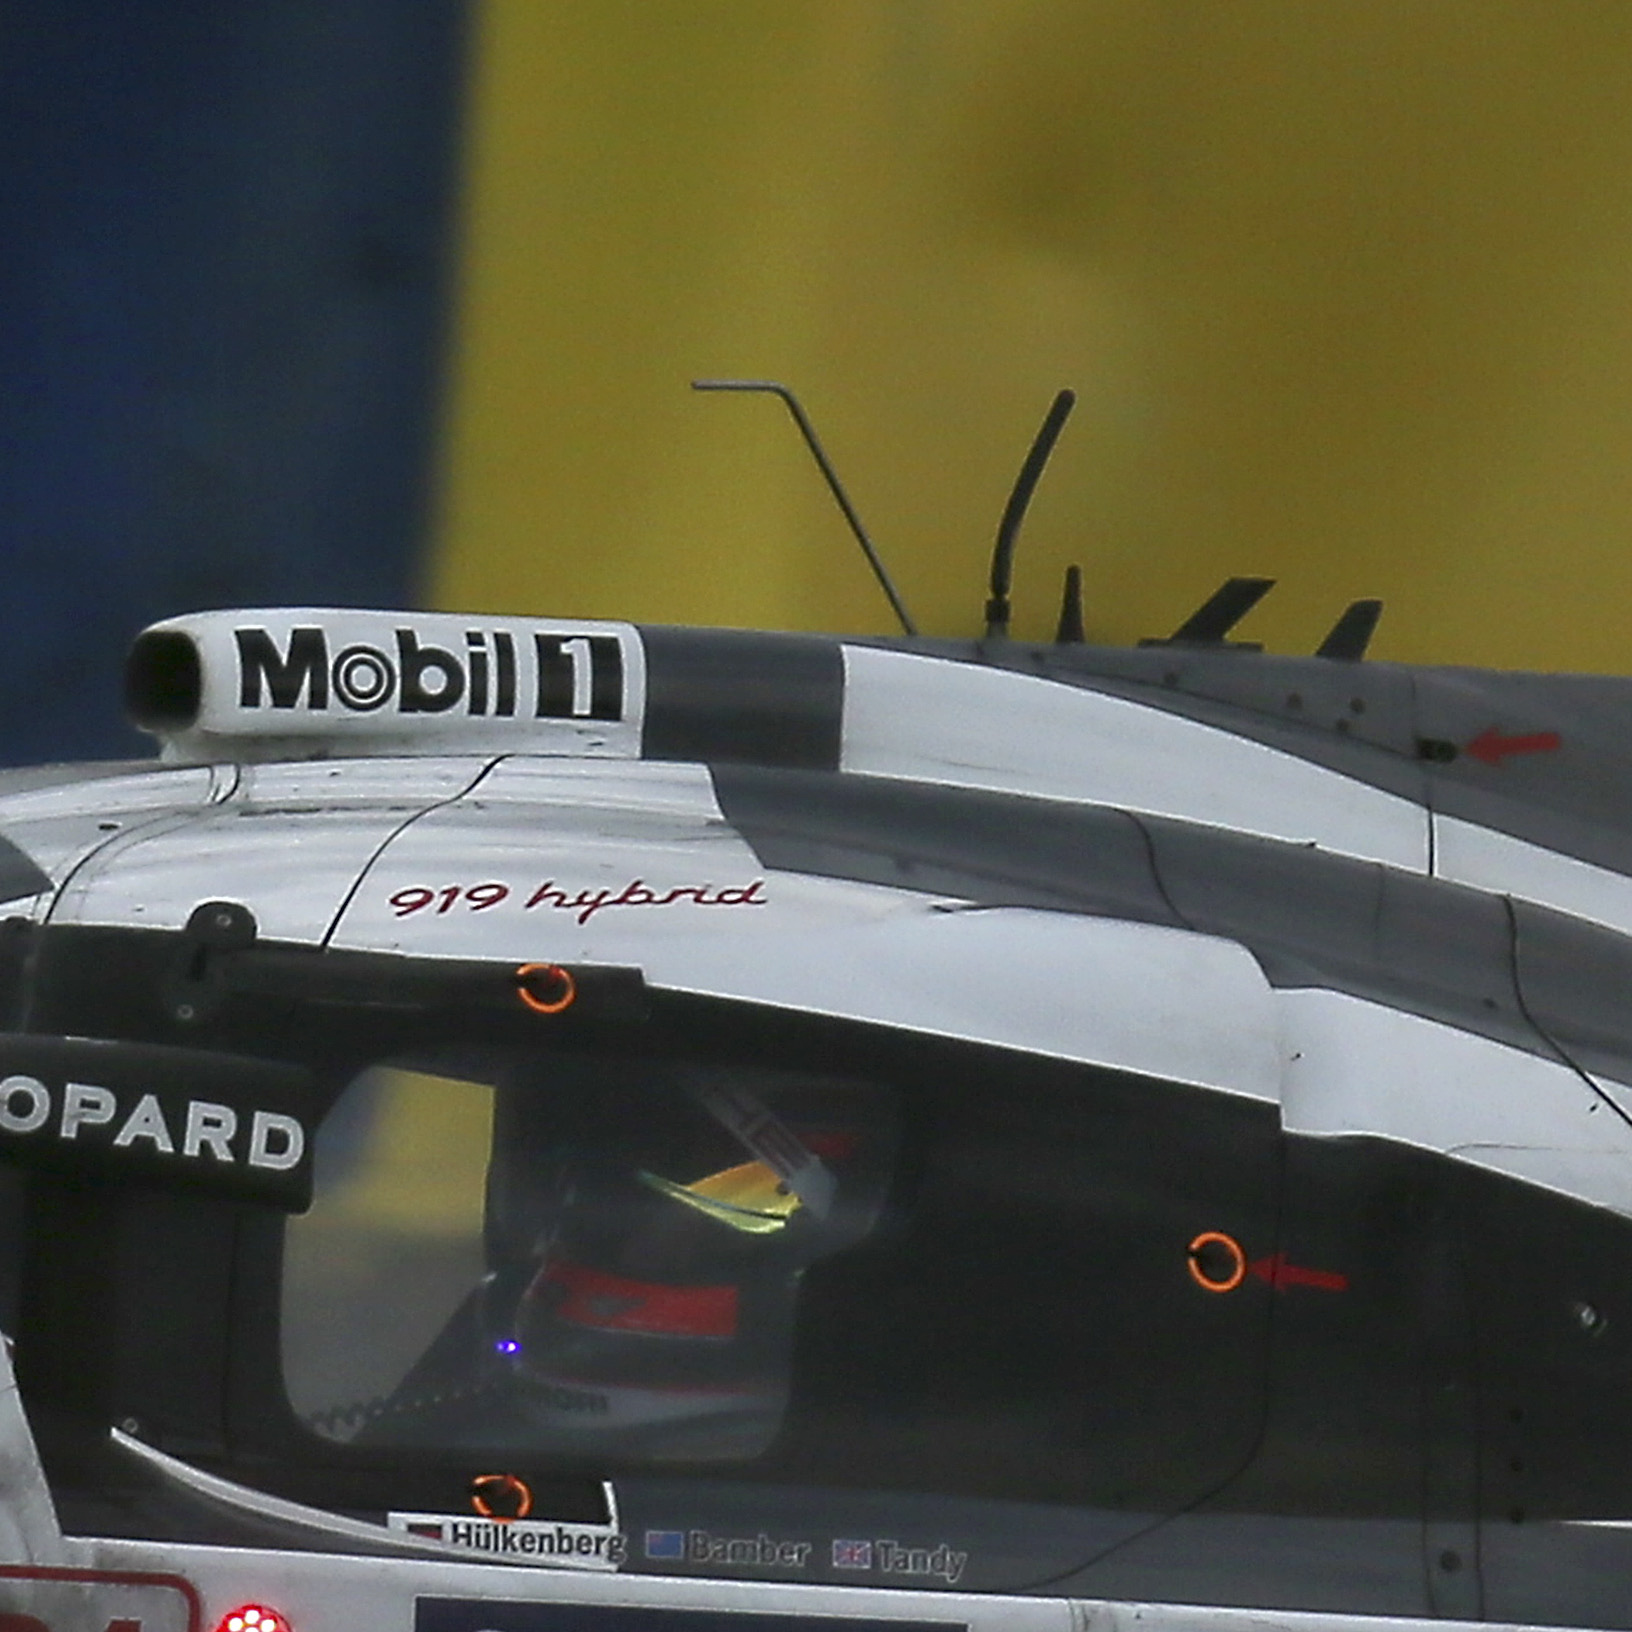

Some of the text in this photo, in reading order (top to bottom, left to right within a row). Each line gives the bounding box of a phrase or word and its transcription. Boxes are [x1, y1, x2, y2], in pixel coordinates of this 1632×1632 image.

[235, 626, 517, 717] Mobil
[389, 879, 768, 925] 919 hybrid
[450, 1522, 626, 1564] Hülkenberg
[689, 1530, 812, 1570] Bamber
[874, 1541, 968, 1584] Tandy
